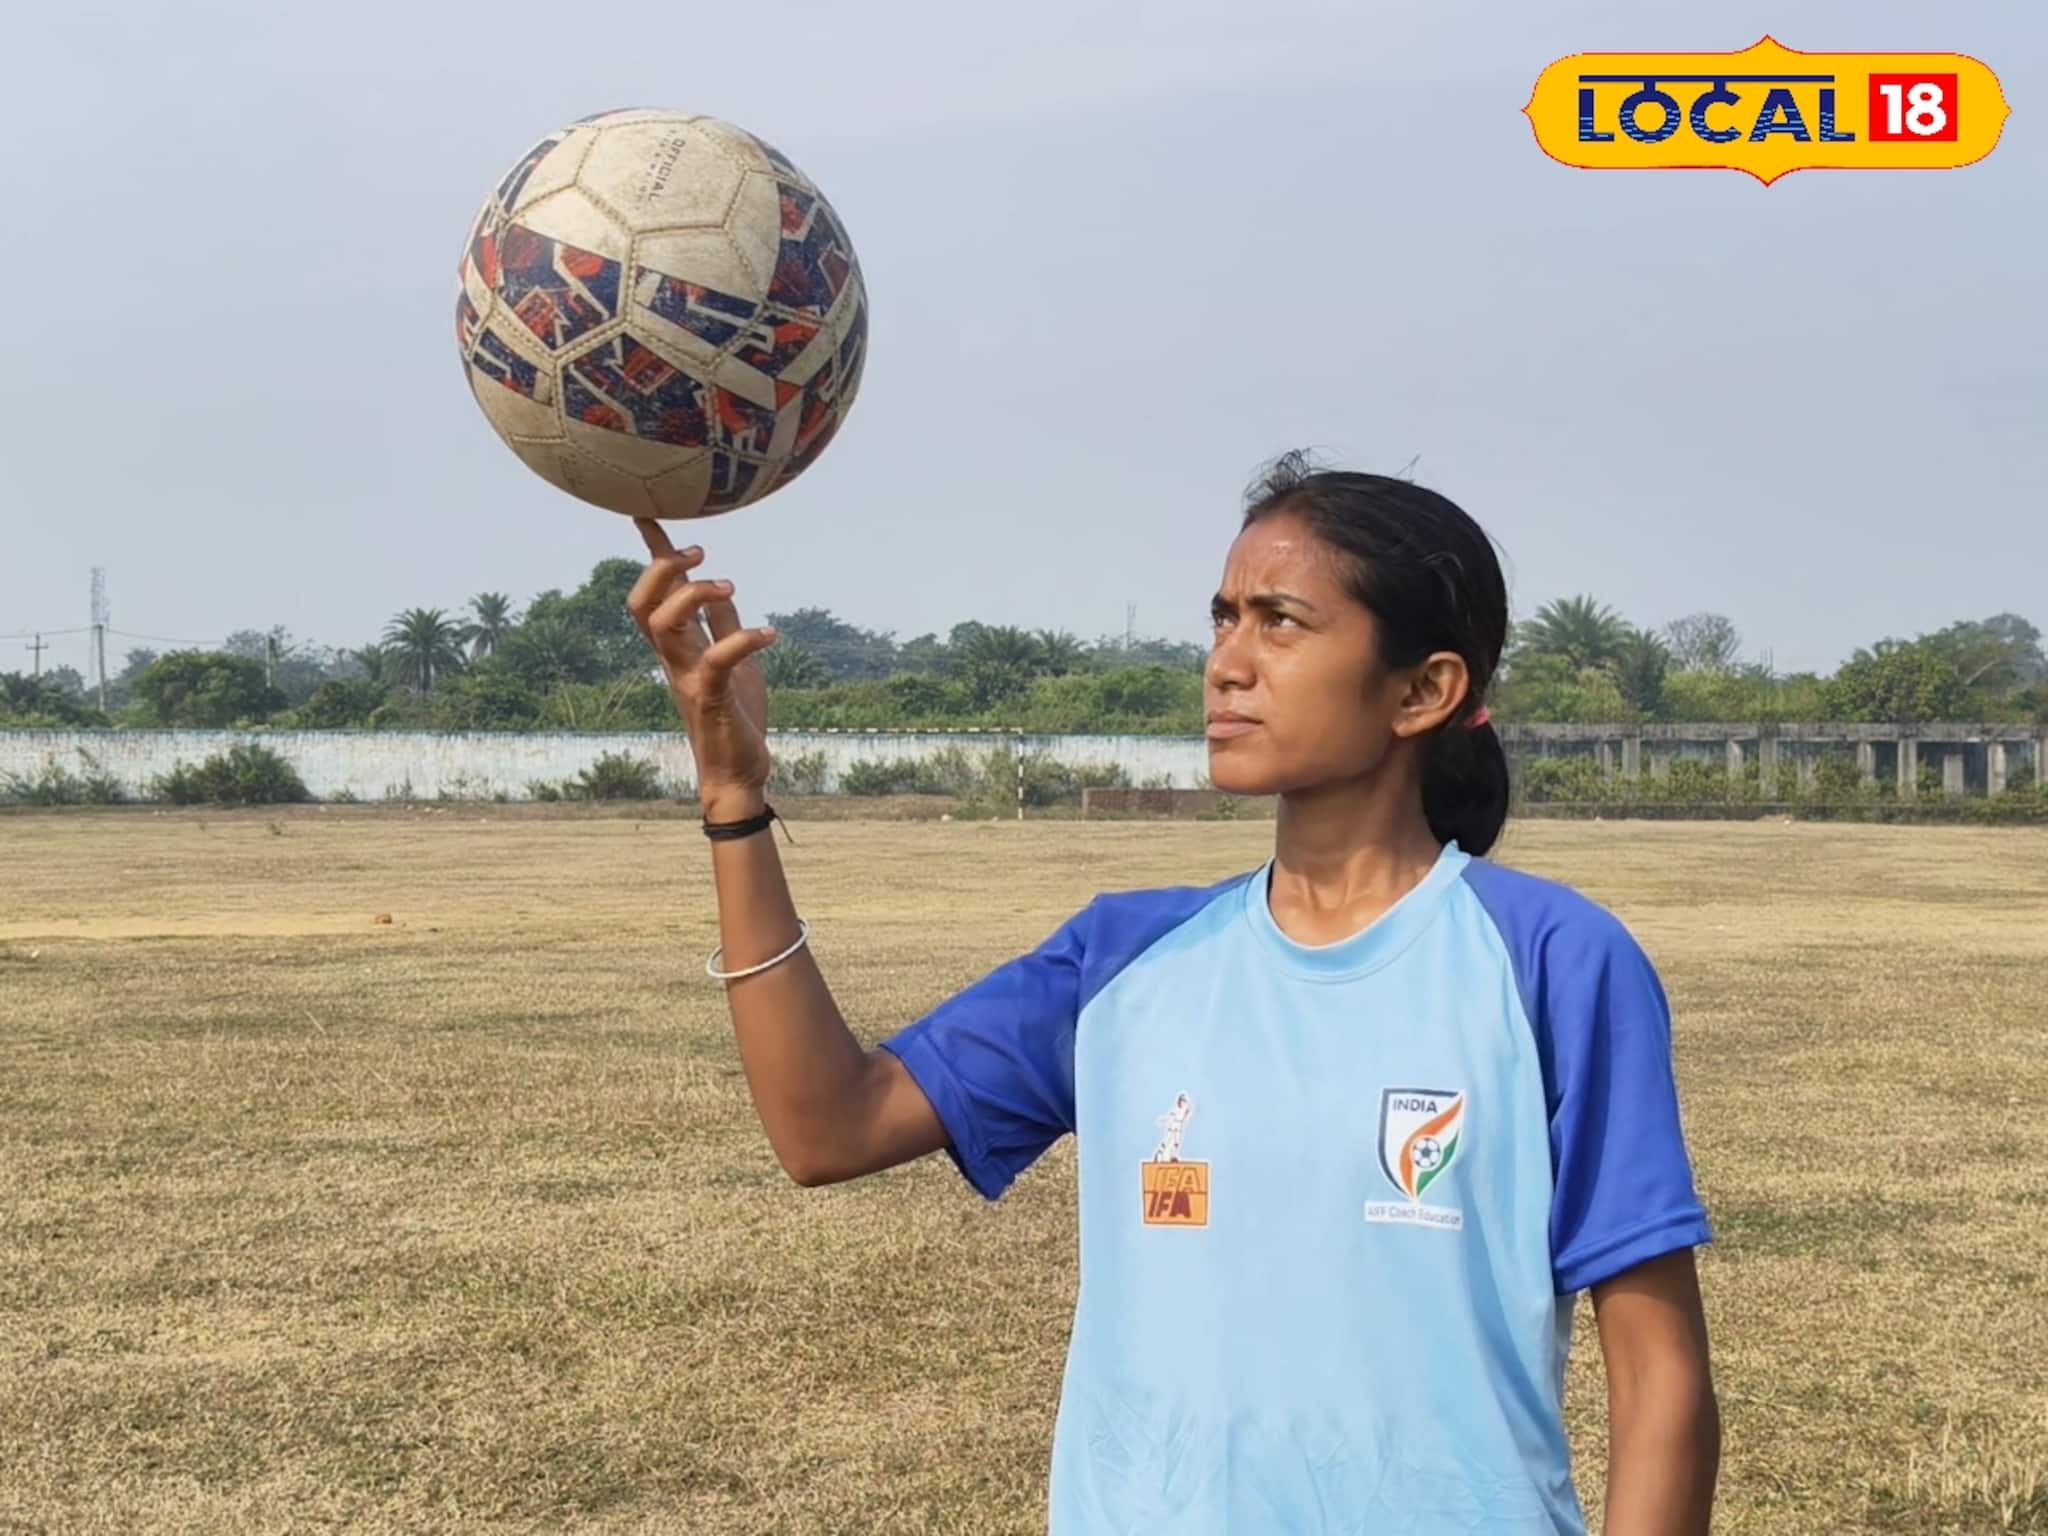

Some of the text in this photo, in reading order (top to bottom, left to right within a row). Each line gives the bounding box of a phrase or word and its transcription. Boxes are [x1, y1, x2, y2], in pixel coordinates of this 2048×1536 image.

[647, 138, 686, 201] OFFICIAL
[1393, 1098, 1438, 1113] INDIA
[1148, 1191, 1192, 1219] IFA
